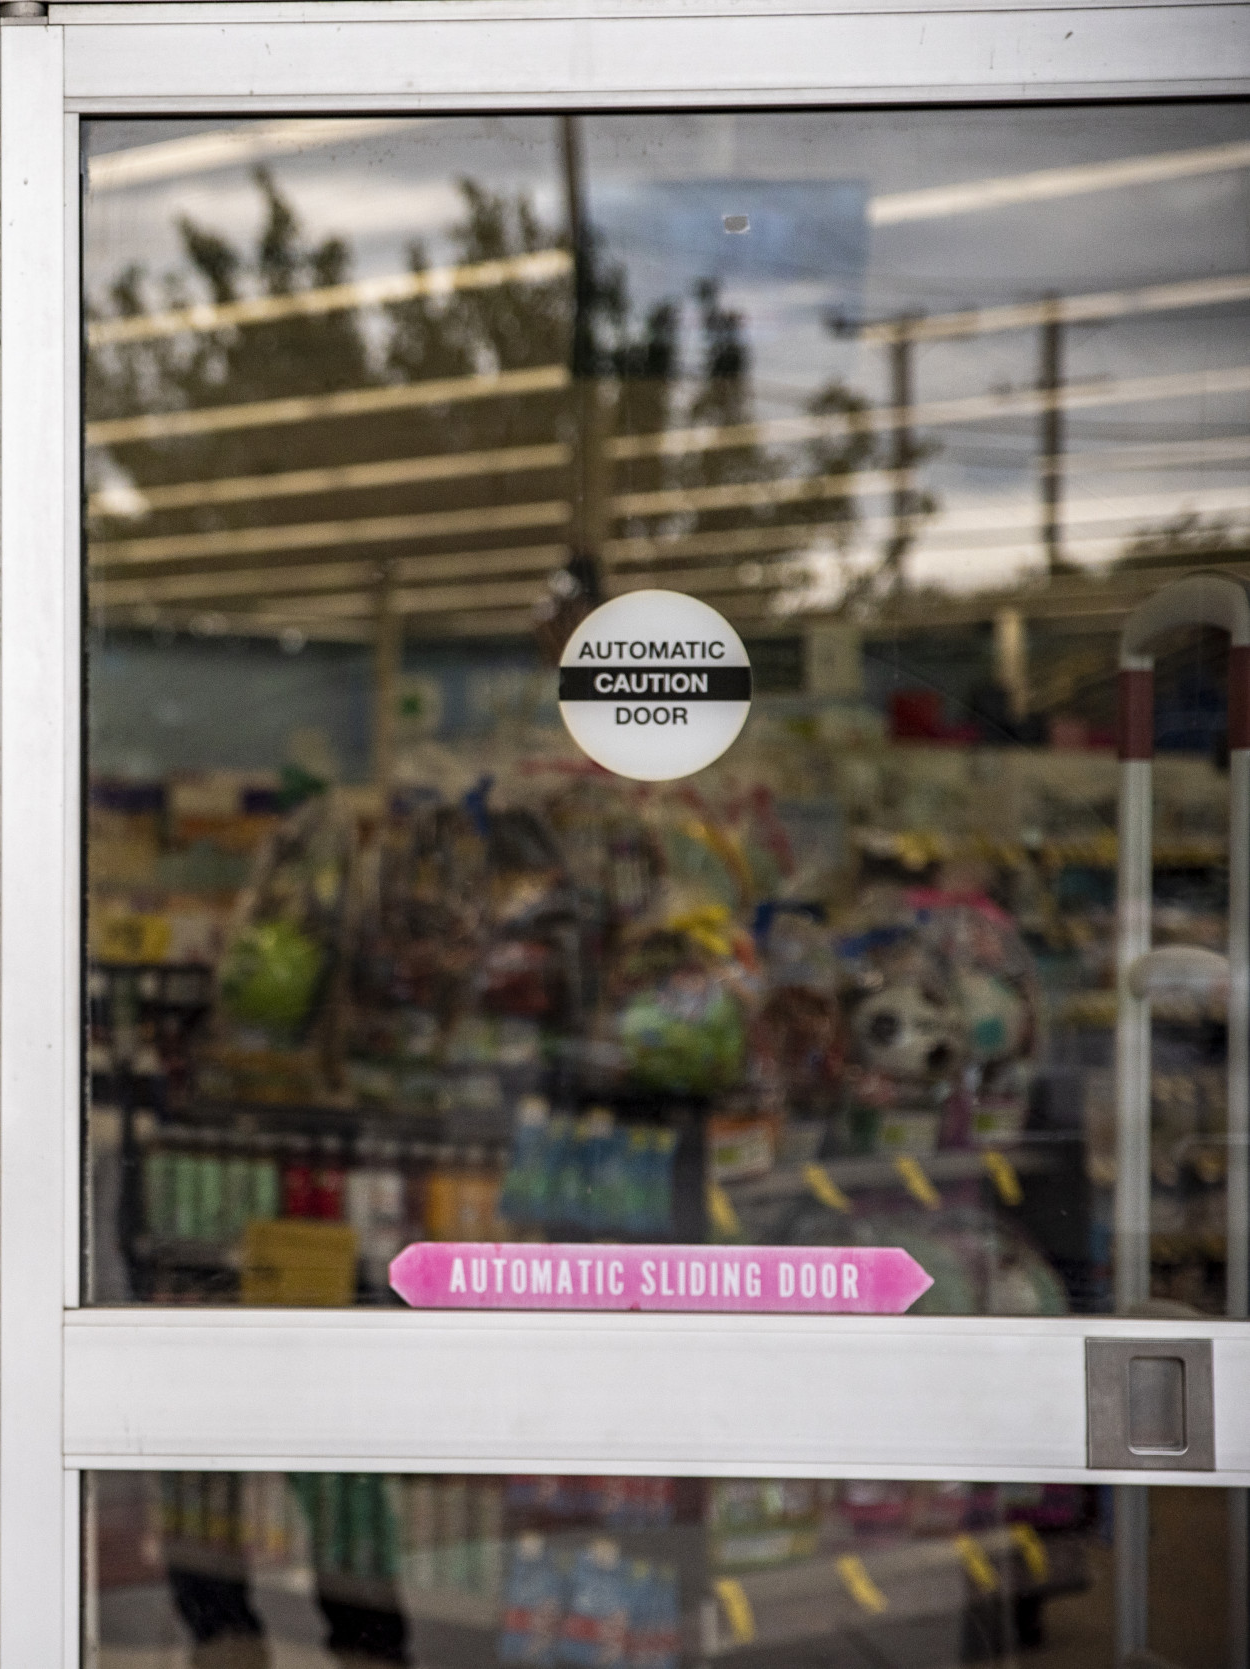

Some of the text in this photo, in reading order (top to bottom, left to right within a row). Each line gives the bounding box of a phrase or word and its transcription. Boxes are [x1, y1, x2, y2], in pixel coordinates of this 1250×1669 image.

[579, 641, 726, 660] AUTOMATIC
[594, 673, 708, 693] CAUTION
[616, 707, 688, 725] DOOR
[449, 1257, 859, 1299] AUTOMATIC SLIDING DOOR
